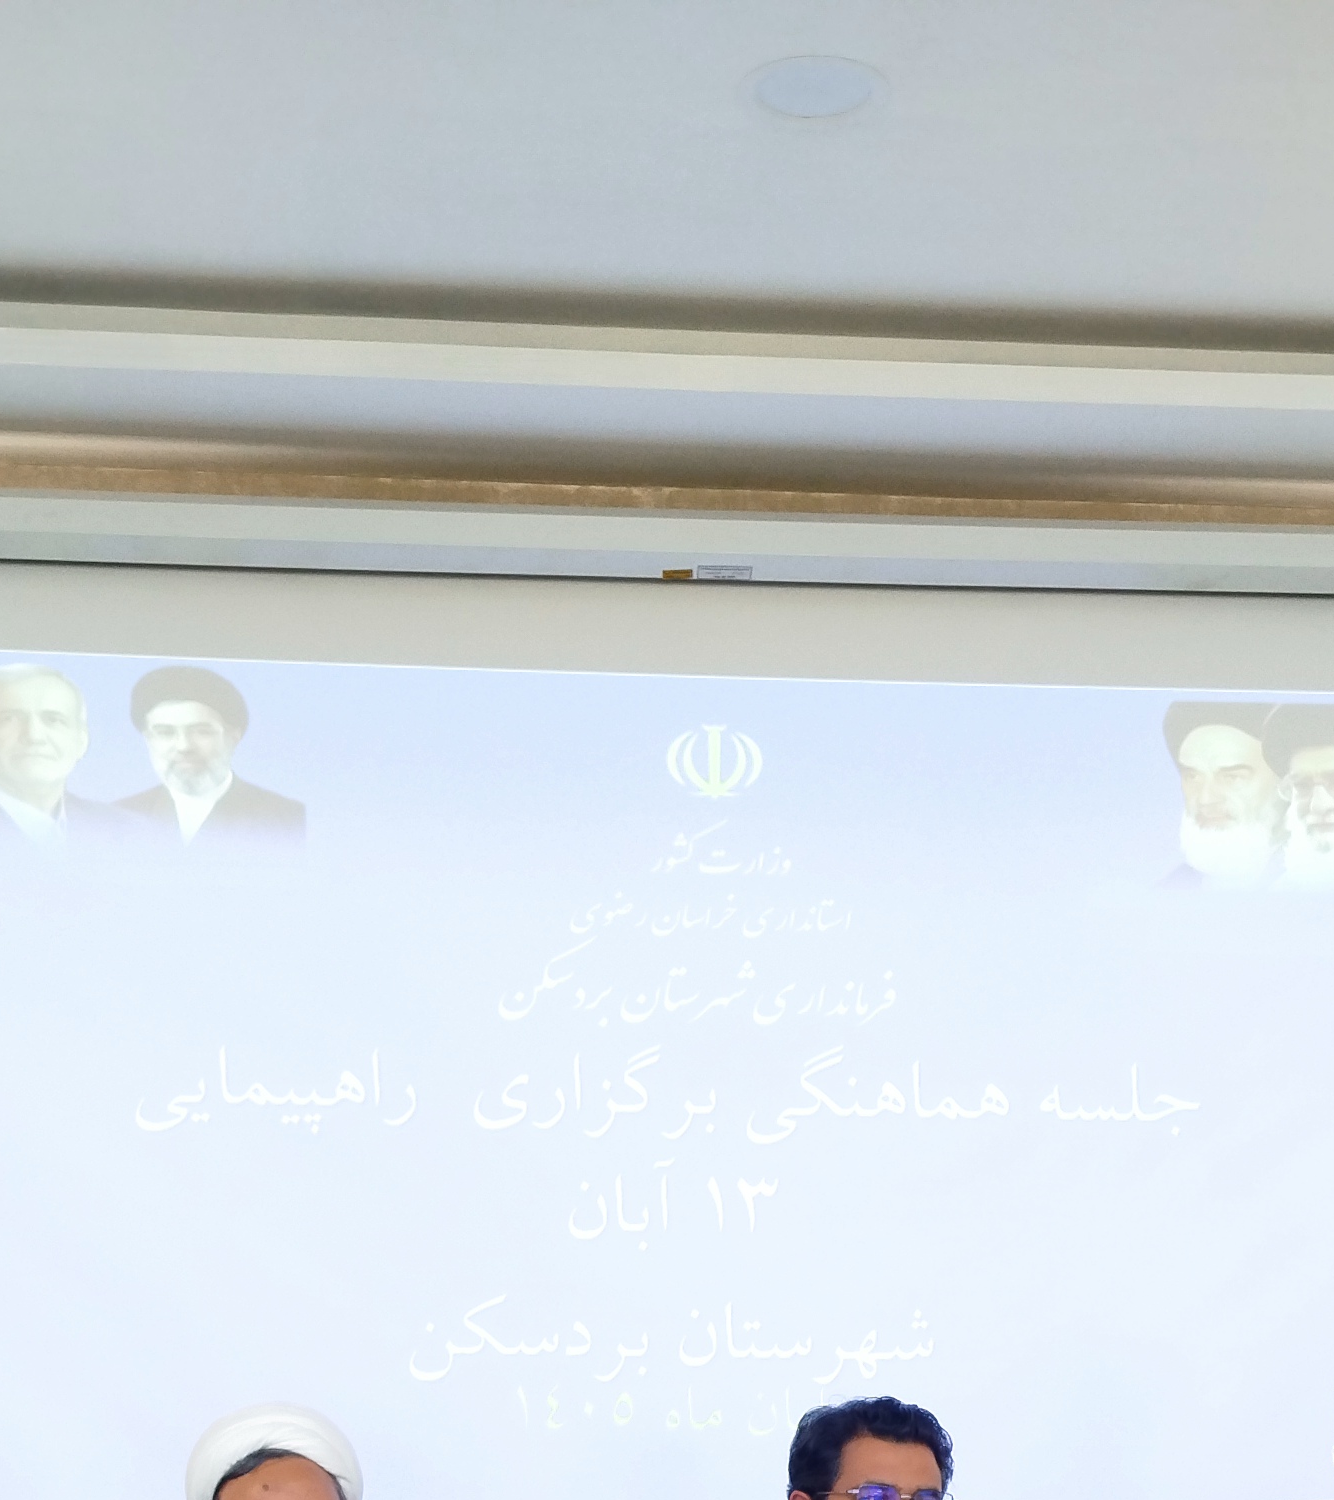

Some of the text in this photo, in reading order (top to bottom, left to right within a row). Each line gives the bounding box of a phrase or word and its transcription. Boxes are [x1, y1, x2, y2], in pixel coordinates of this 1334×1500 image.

[651, 818, 792, 876] وزارت کشور
[569, 890, 853, 939] استانداری خراسان رضوی
[498, 934, 897, 1027] فرمانداری شهرستان بردسکن
[136, 1044, 1202, 1145] جلسه هماهنگی برگزاری راهپیمایی
[567, 1157, 677, 1253] آبان
[408, 1293, 936, 1386] شهرستان بردسکن
